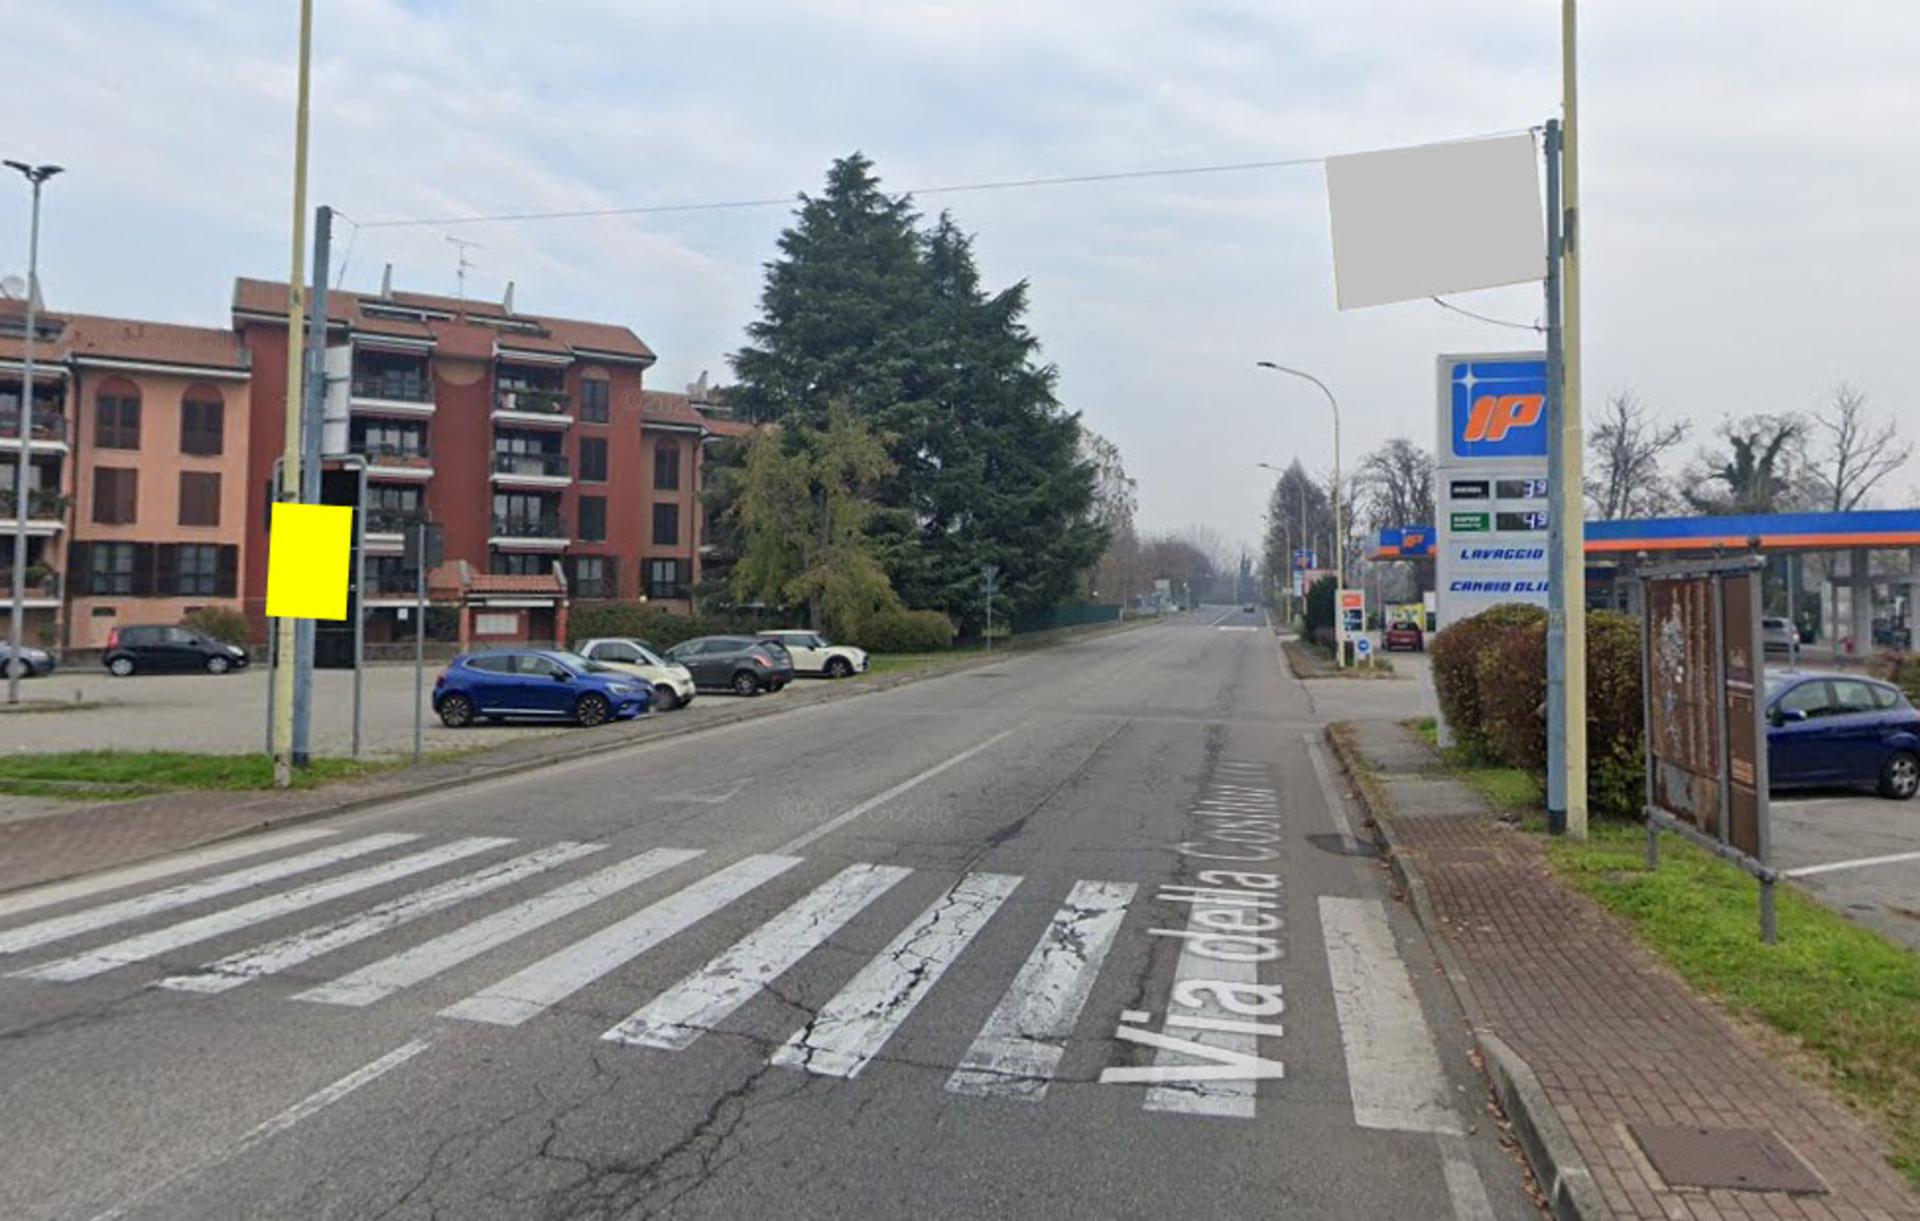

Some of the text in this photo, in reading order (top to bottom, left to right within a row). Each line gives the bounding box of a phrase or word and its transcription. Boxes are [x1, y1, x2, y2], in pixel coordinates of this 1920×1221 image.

[1463, 394, 1545, 442] IP
[1461, 549, 1544, 560] LAVAGGIO
[1450, 581, 1511, 592] CAMBIO
